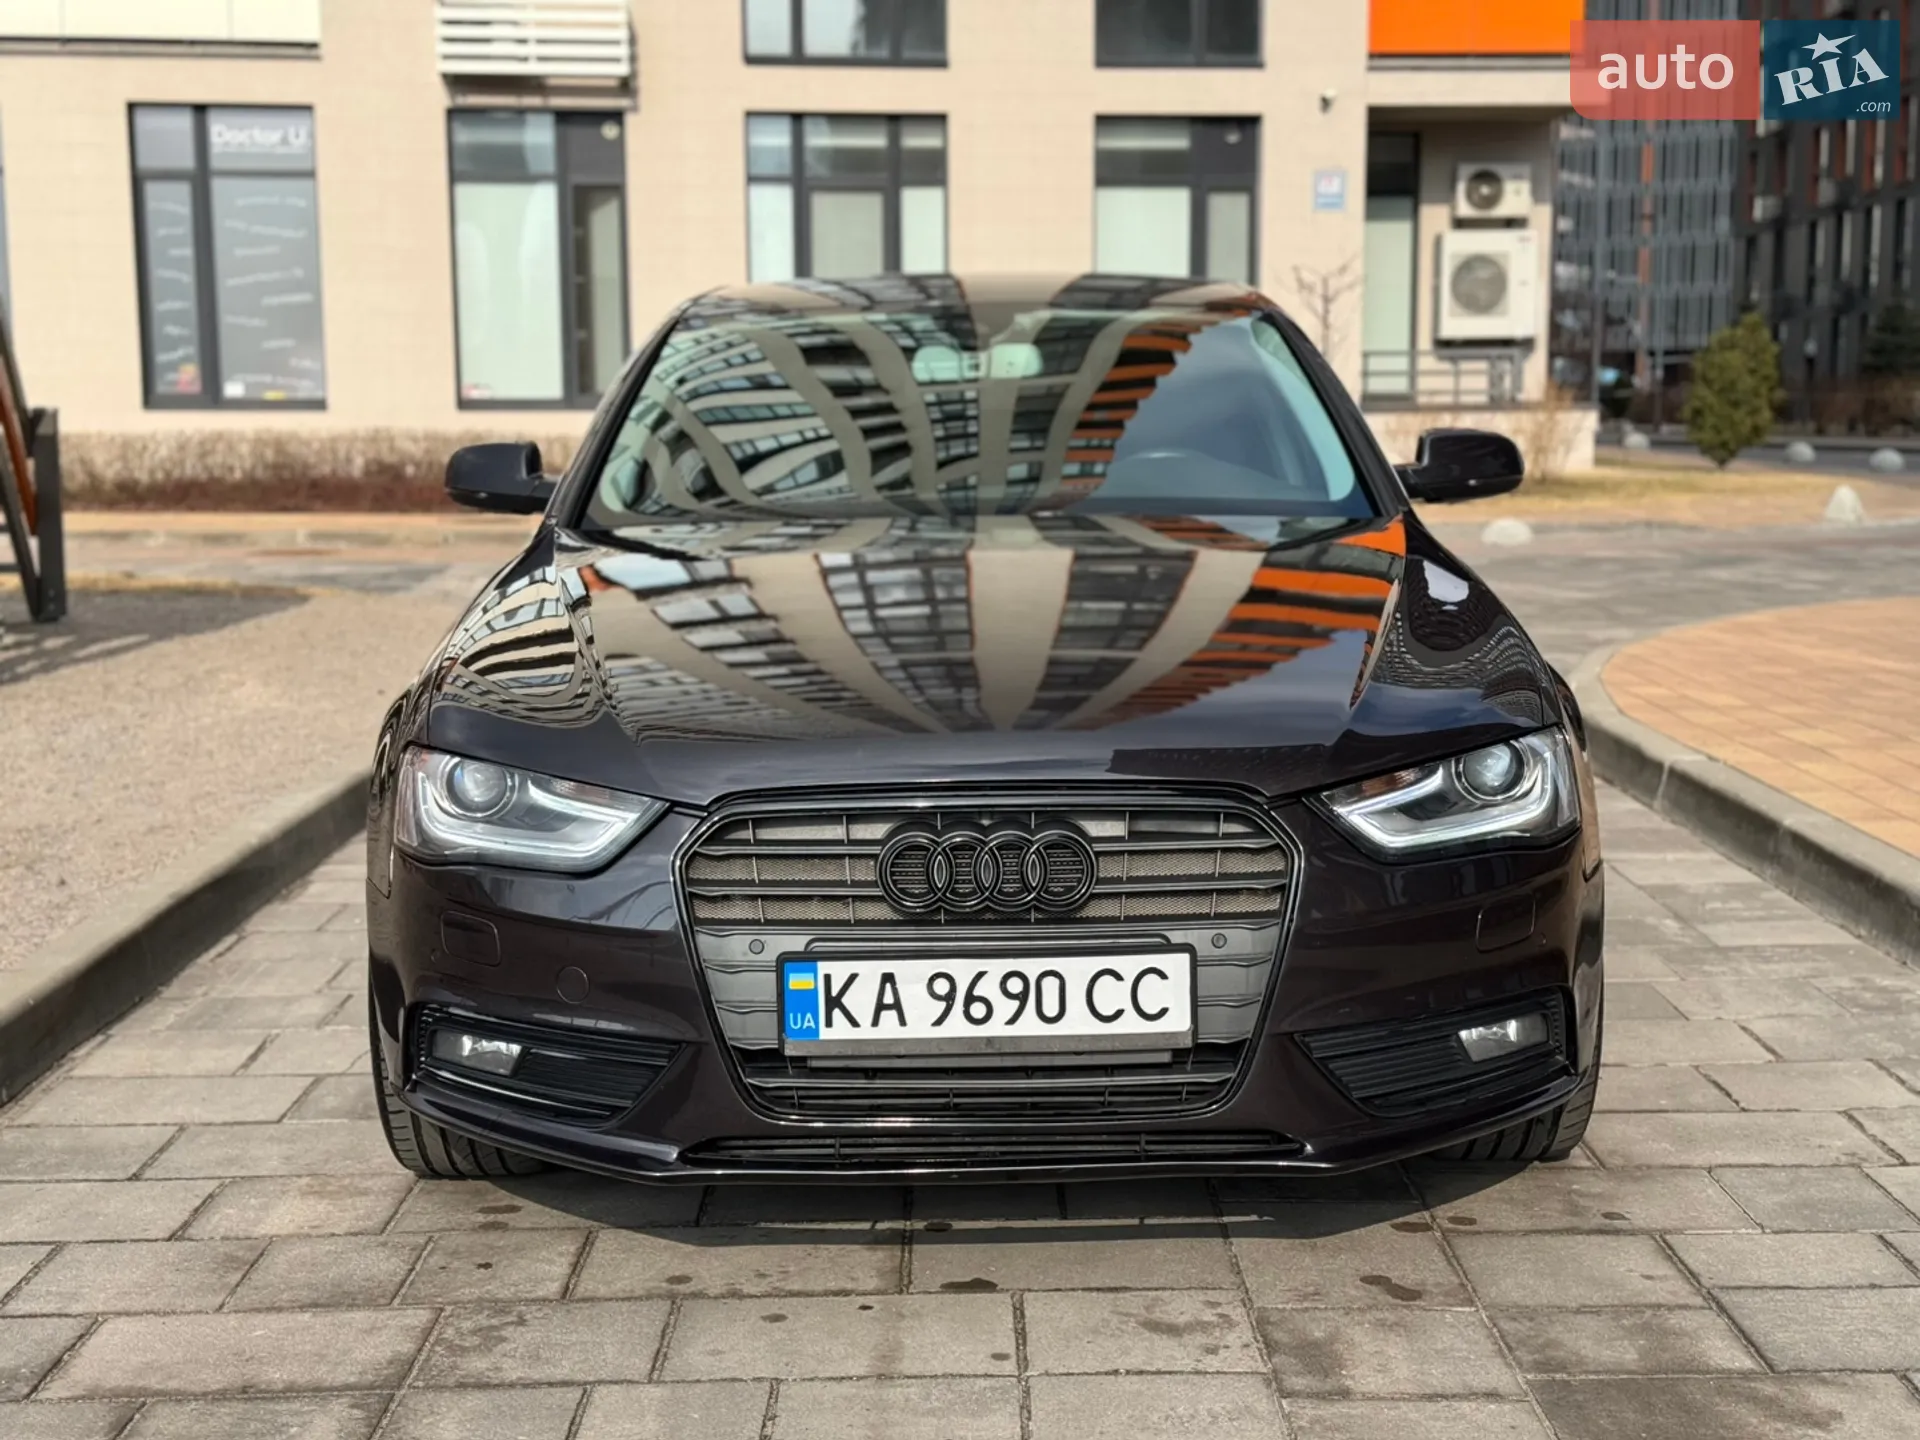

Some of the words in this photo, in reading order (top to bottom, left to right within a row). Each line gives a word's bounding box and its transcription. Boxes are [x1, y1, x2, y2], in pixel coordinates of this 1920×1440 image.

[823, 972, 907, 1028] KA
[926, 970, 1067, 1027] 9690
[1085, 966, 1171, 1024] CC
[789, 1013, 816, 1030] UA
